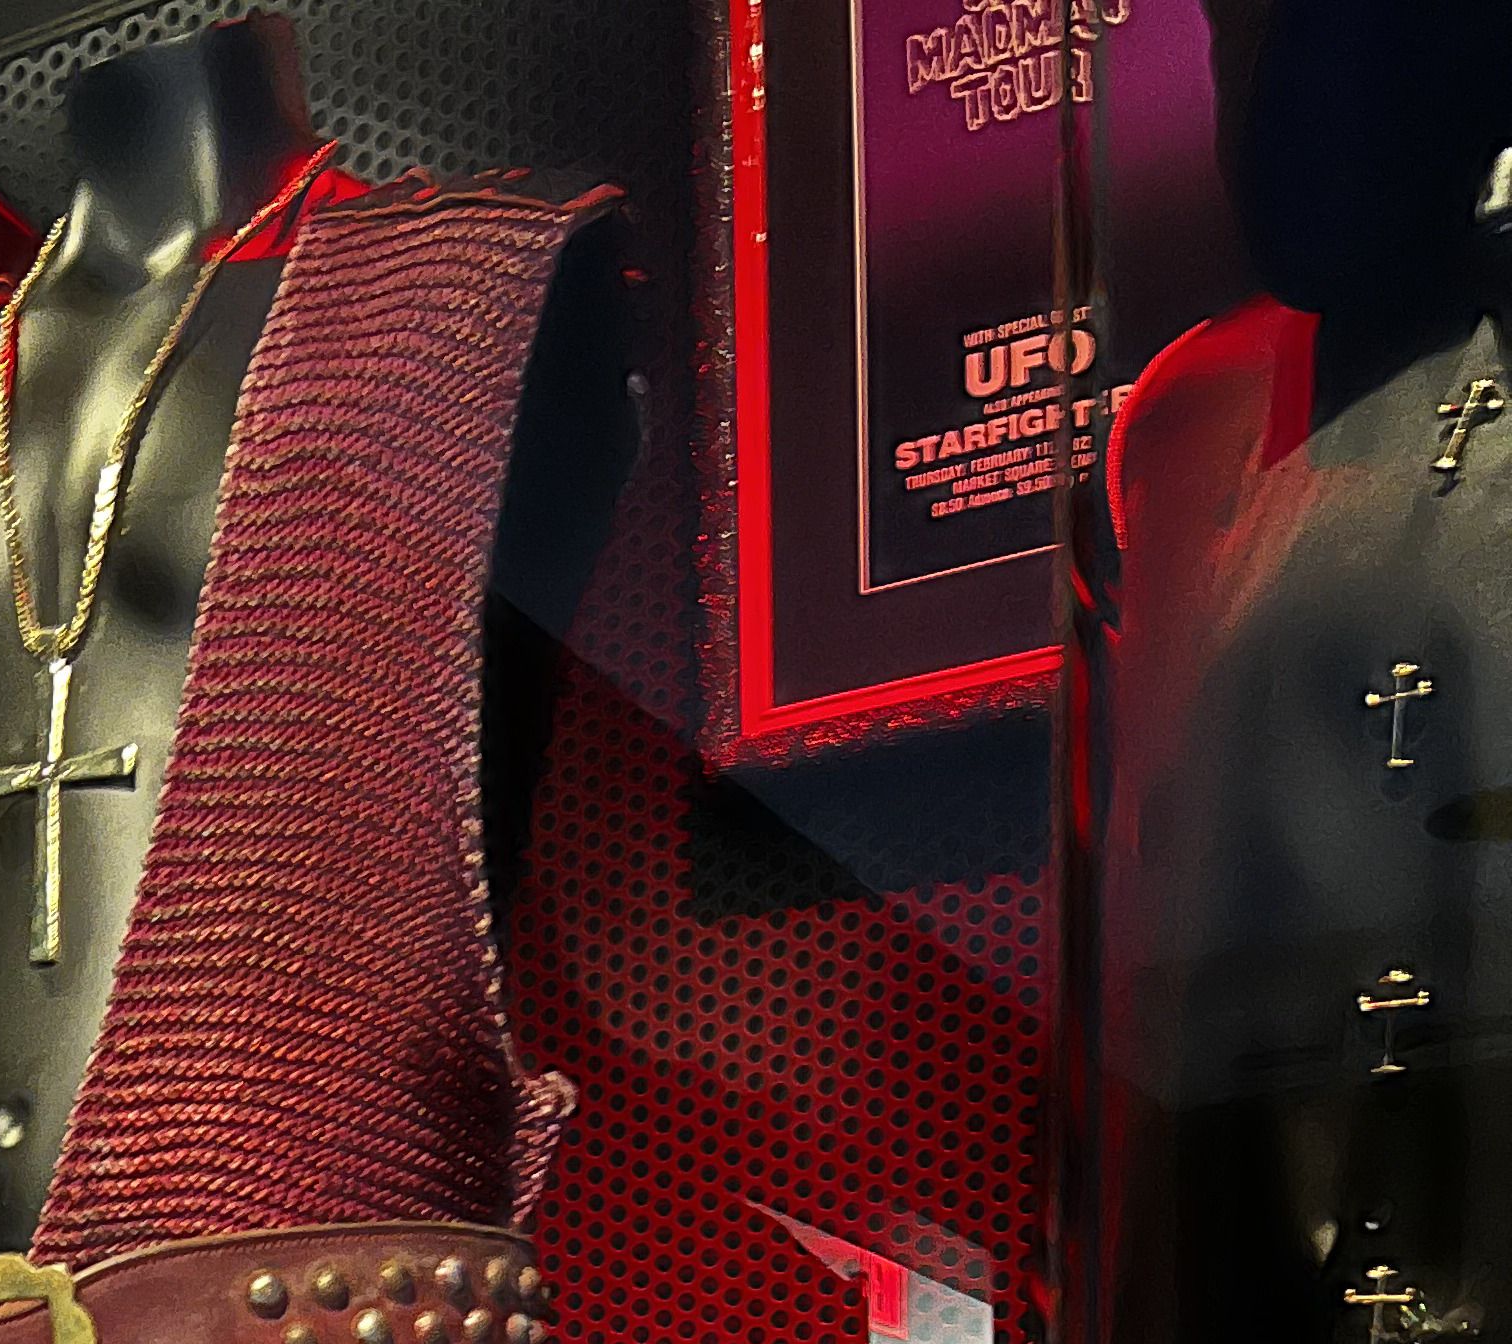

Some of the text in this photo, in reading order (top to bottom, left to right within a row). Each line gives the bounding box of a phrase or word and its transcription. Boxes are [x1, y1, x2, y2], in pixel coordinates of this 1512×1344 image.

[950, 48, 1093, 131] TOUR
[965, 329, 1096, 398] UFO
[997, 314, 1049, 339] SPECIAL
[894, 384, 1133, 471] STARFIGHTR
